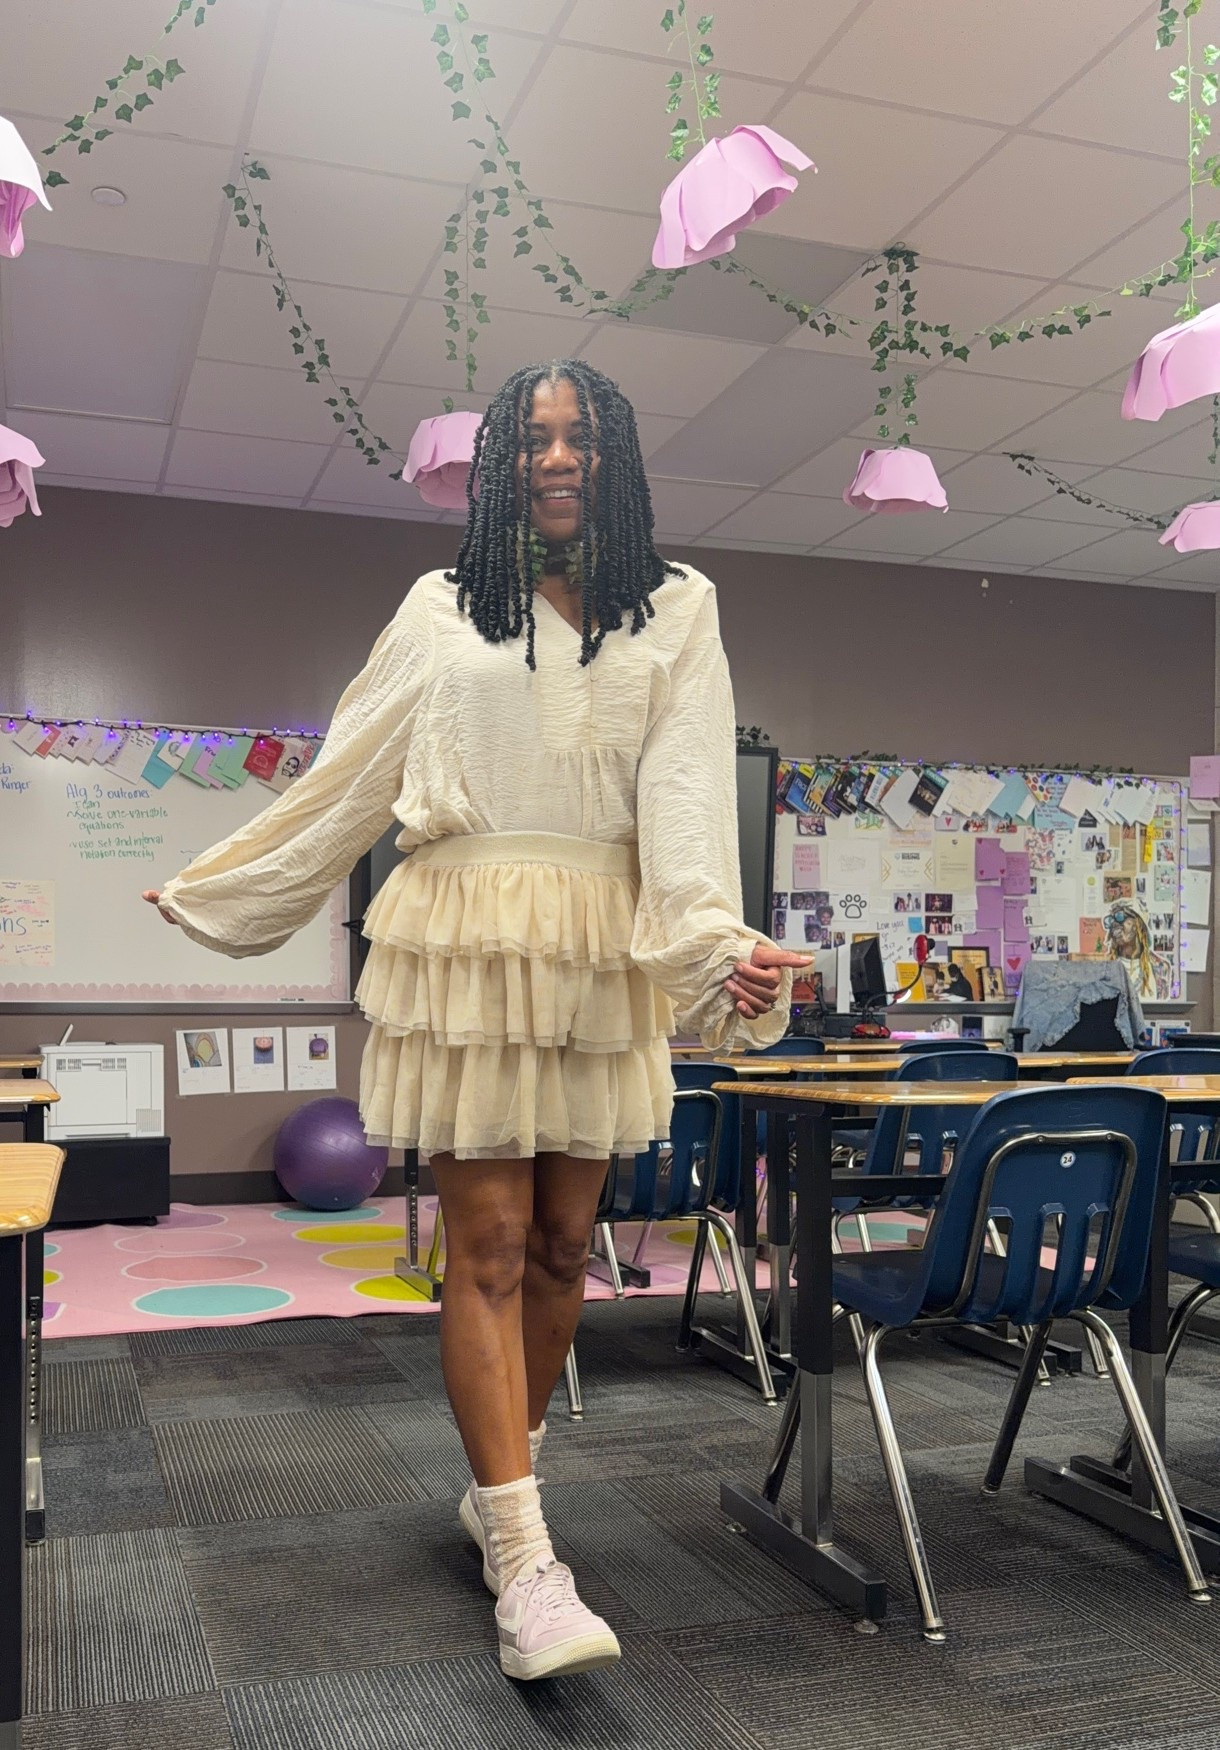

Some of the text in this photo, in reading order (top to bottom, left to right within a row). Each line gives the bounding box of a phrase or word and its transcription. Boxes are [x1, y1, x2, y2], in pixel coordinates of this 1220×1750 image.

[66, 783, 88, 801] Alg
[93, 784, 102, 798] 3
[0, 916, 26, 935] ns
[1063, 1155, 1073, 1164] 24
